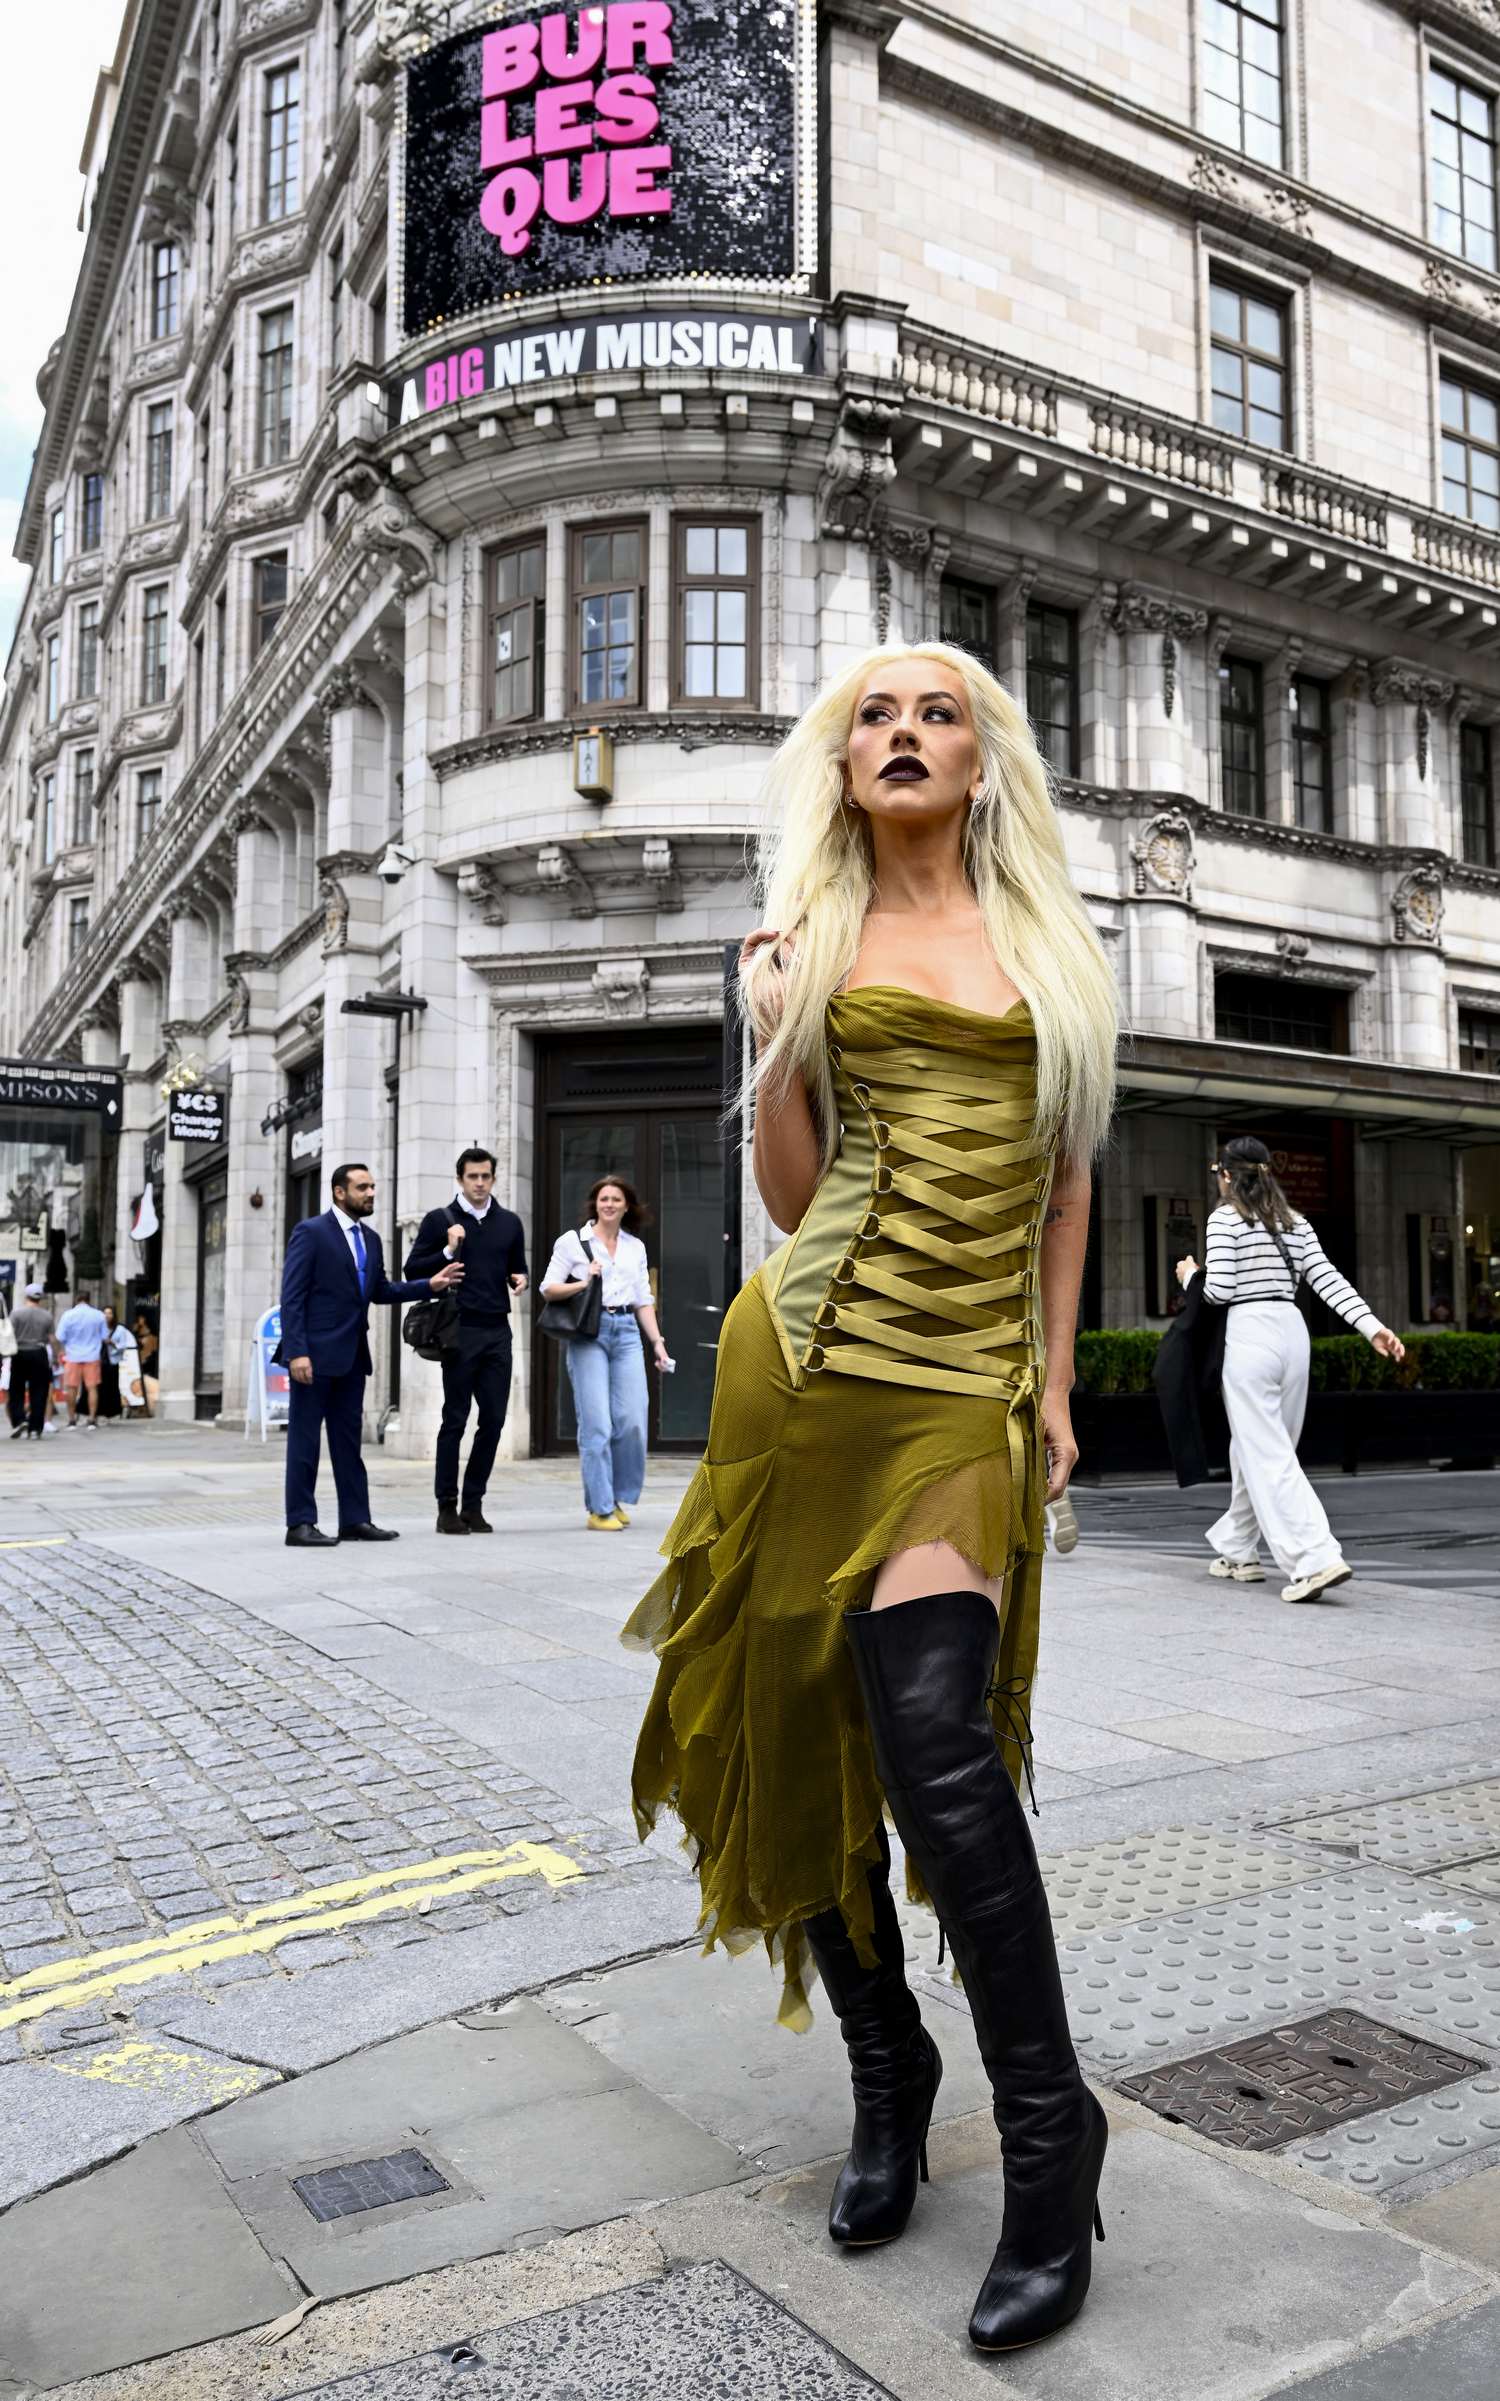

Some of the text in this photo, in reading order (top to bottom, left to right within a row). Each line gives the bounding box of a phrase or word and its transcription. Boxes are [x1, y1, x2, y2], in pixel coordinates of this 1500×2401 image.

[482, 1, 673, 98] BUR
[480, 73, 660, 170] LES
[479, 145, 673, 256] QUE
[400, 320, 804, 425] A BIG NEW MUSICAL
[170, 1112, 222, 1128] Change
[174, 1125, 219, 1141] Money
[1215, 2043, 1380, 2113] METER
